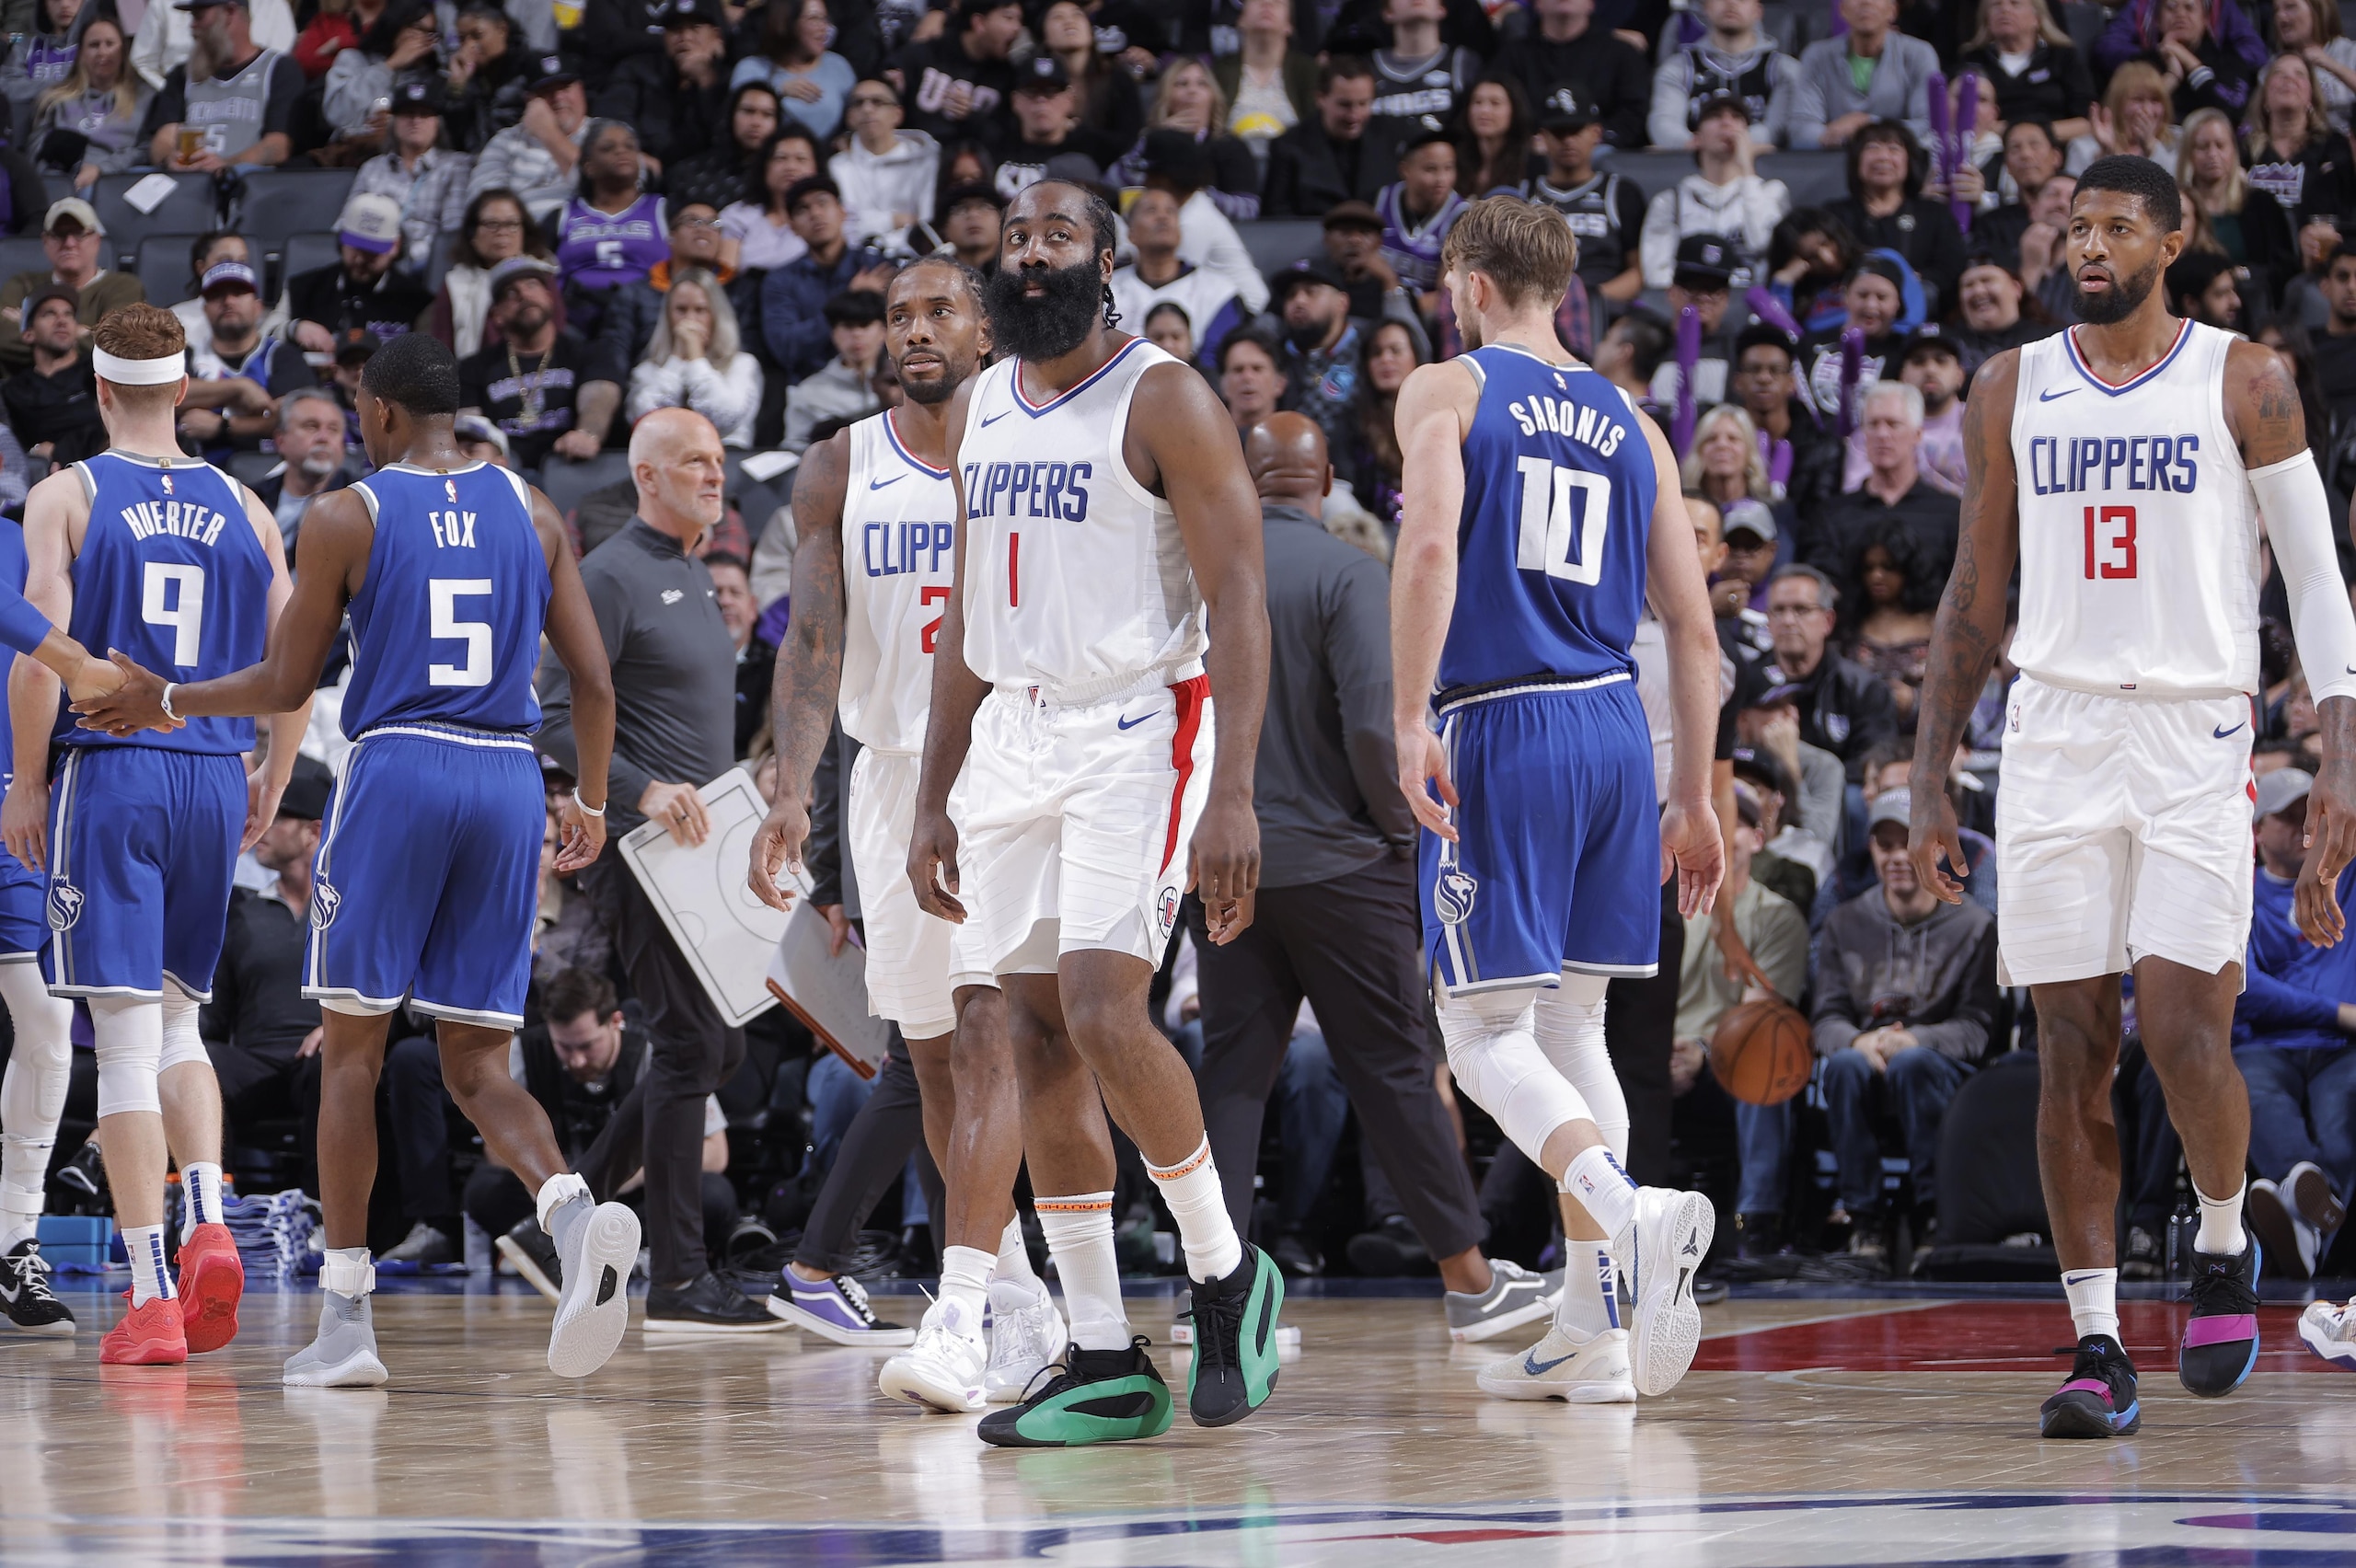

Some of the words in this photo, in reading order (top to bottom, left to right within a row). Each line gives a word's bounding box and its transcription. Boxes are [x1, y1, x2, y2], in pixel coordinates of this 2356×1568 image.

[595, 240, 625, 269] 5
[1509, 395, 1625, 456] SABONIS
[2030, 434, 2199, 495] CLIPPERS
[120, 500, 226, 548] HUERTER
[428, 511, 478, 549] FOX
[861, 522, 955, 577] CLIPP
[1516, 455, 1611, 587] 10
[2083, 505, 2138, 580] 13
[1009, 532, 1019, 607] 1
[141, 561, 206, 667] 9
[428, 578, 493, 687] 5
[920, 586, 952, 653] 2
